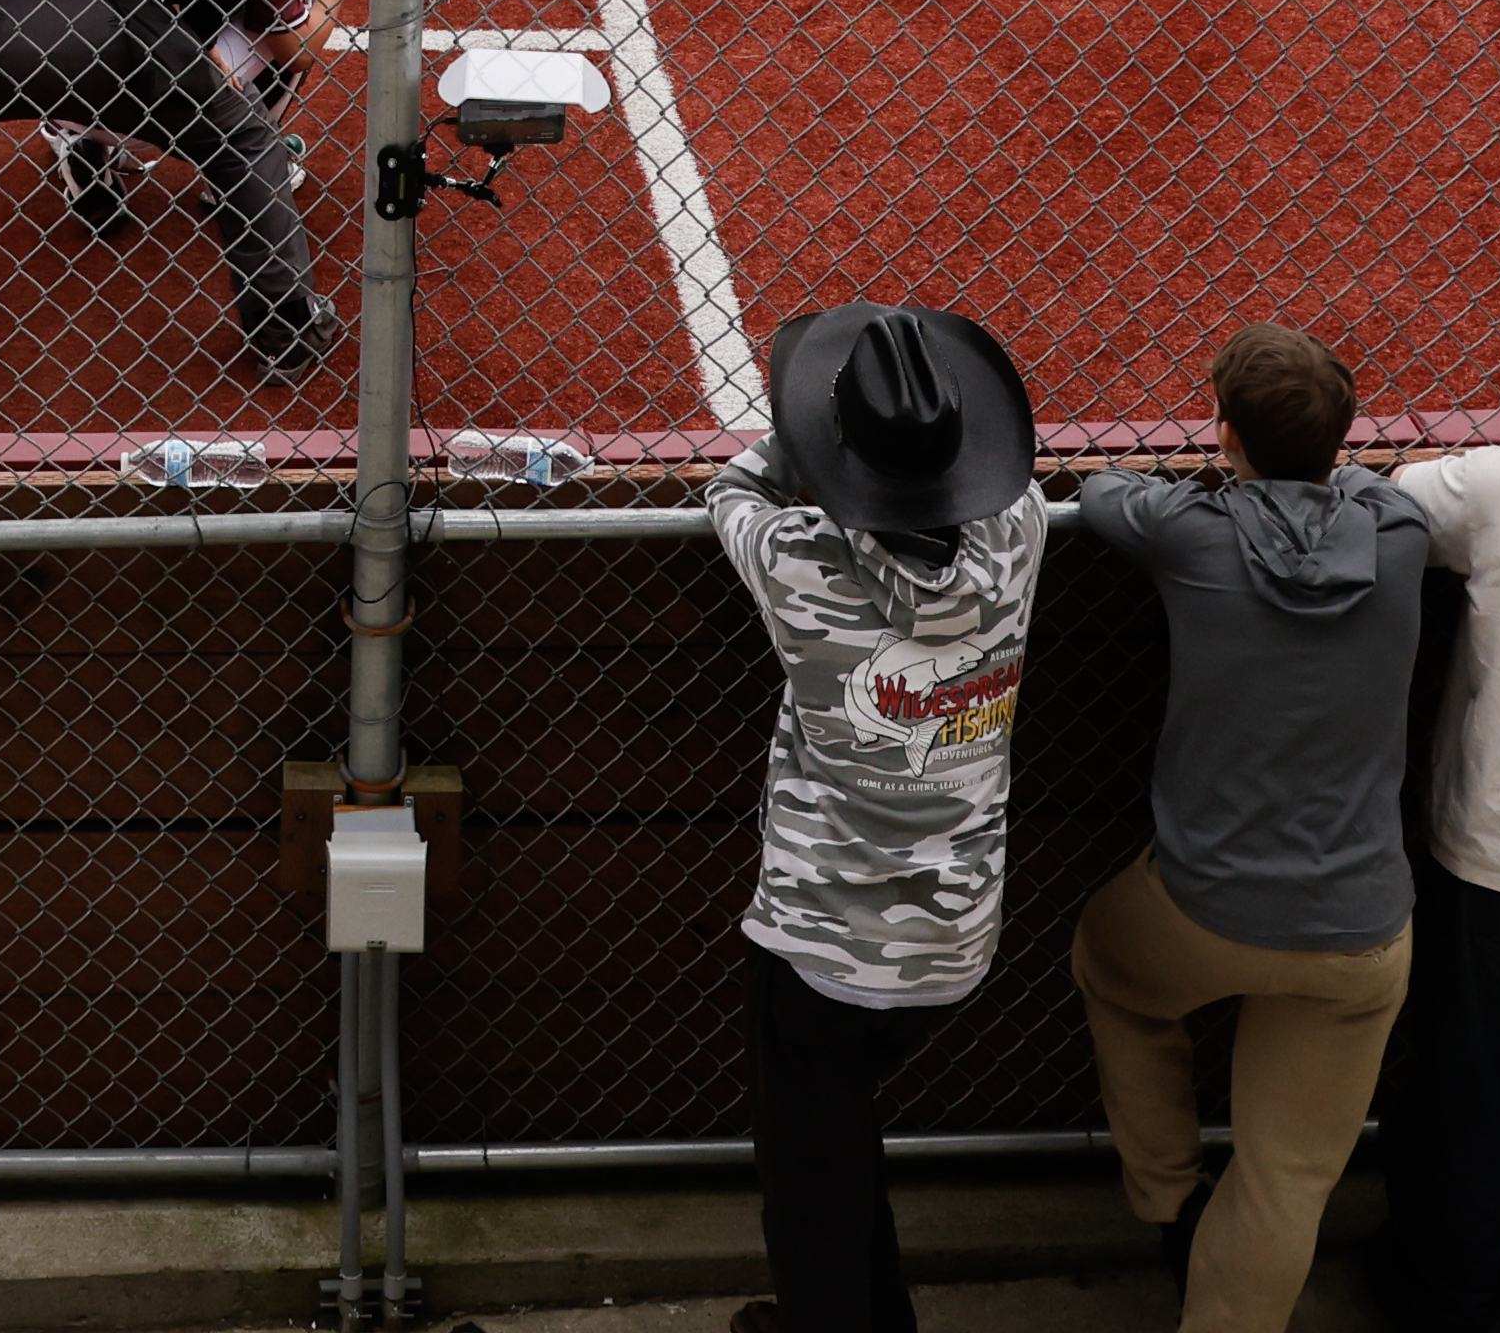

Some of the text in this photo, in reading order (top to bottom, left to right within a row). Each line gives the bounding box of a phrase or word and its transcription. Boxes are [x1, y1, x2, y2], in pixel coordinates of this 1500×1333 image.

[857, 778, 882, 790] COME
[884, 781, 896, 791] AS
[898, 782, 905, 791] A
[907, 780, 937, 792] CLIENT,
